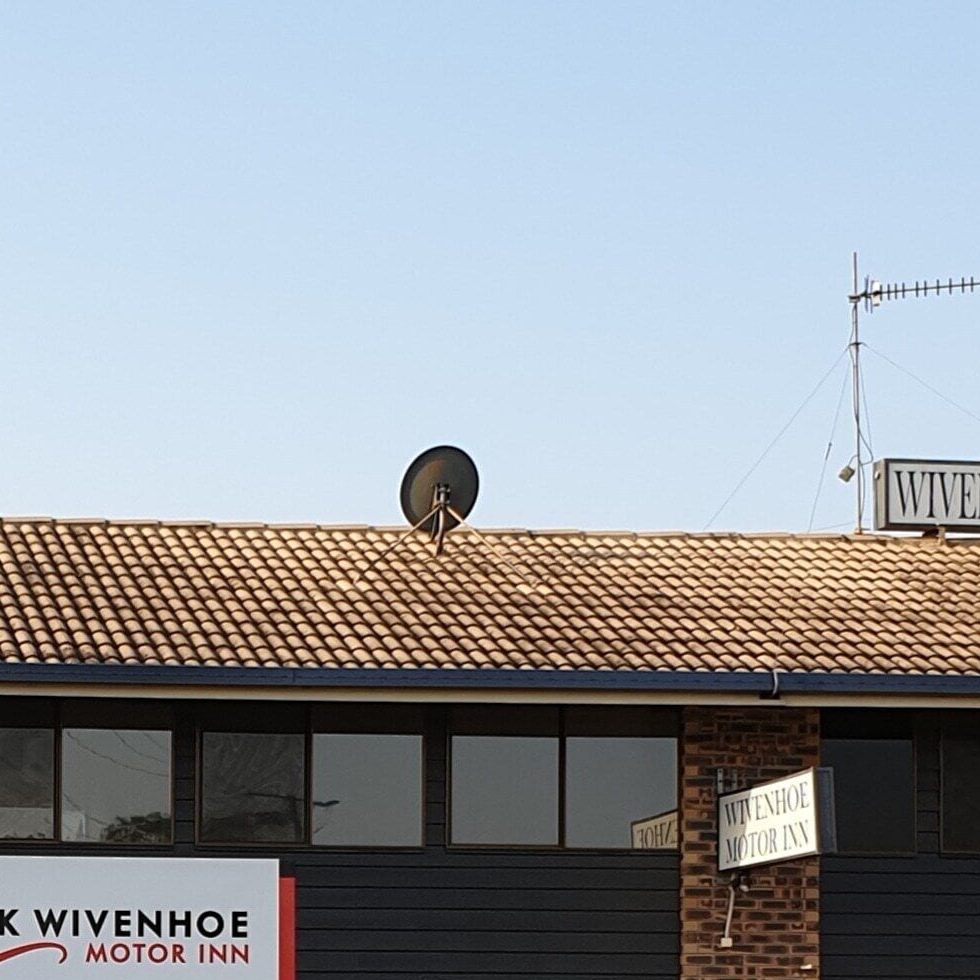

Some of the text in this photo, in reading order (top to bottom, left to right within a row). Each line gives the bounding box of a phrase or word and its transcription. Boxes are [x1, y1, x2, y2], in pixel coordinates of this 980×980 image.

[894, 471, 980, 519] WIVE
[725, 781, 809, 826] WIVENHOE
[725, 820, 809, 864] MOTOR INN
[33, 908, 248, 938] WIVENHOE
[85, 943, 249, 964] MOTOR INN
